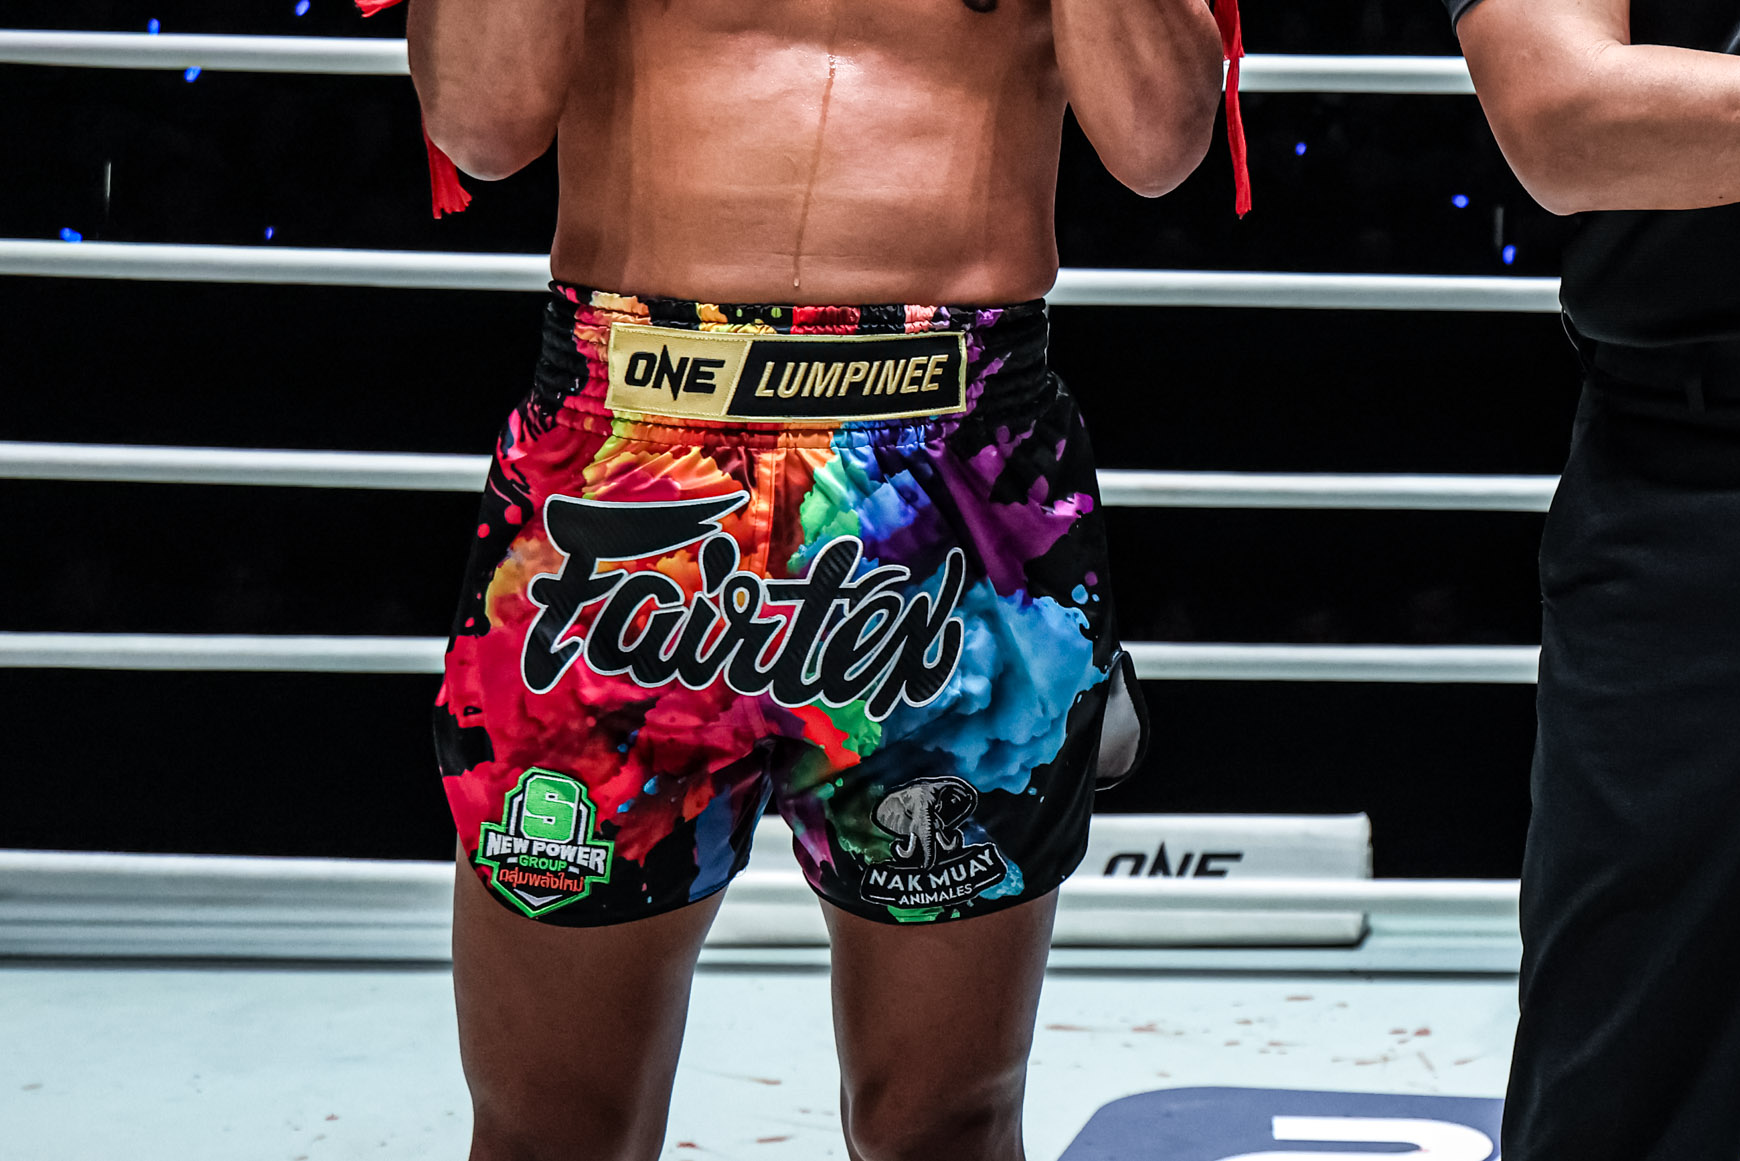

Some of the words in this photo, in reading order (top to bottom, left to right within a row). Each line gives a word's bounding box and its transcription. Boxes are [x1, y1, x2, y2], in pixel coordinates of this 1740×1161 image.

[624, 344, 726, 401] ONE
[754, 353, 949, 399] LUMPINEE
[520, 489, 967, 723] Fairtex
[486, 830, 530, 858] NEW
[531, 840, 608, 876] POWER
[518, 854, 568, 872] GROUP
[869, 870, 923, 892] NAK
[929, 848, 995, 890] MUAY
[897, 883, 973, 907] ANIMALES
